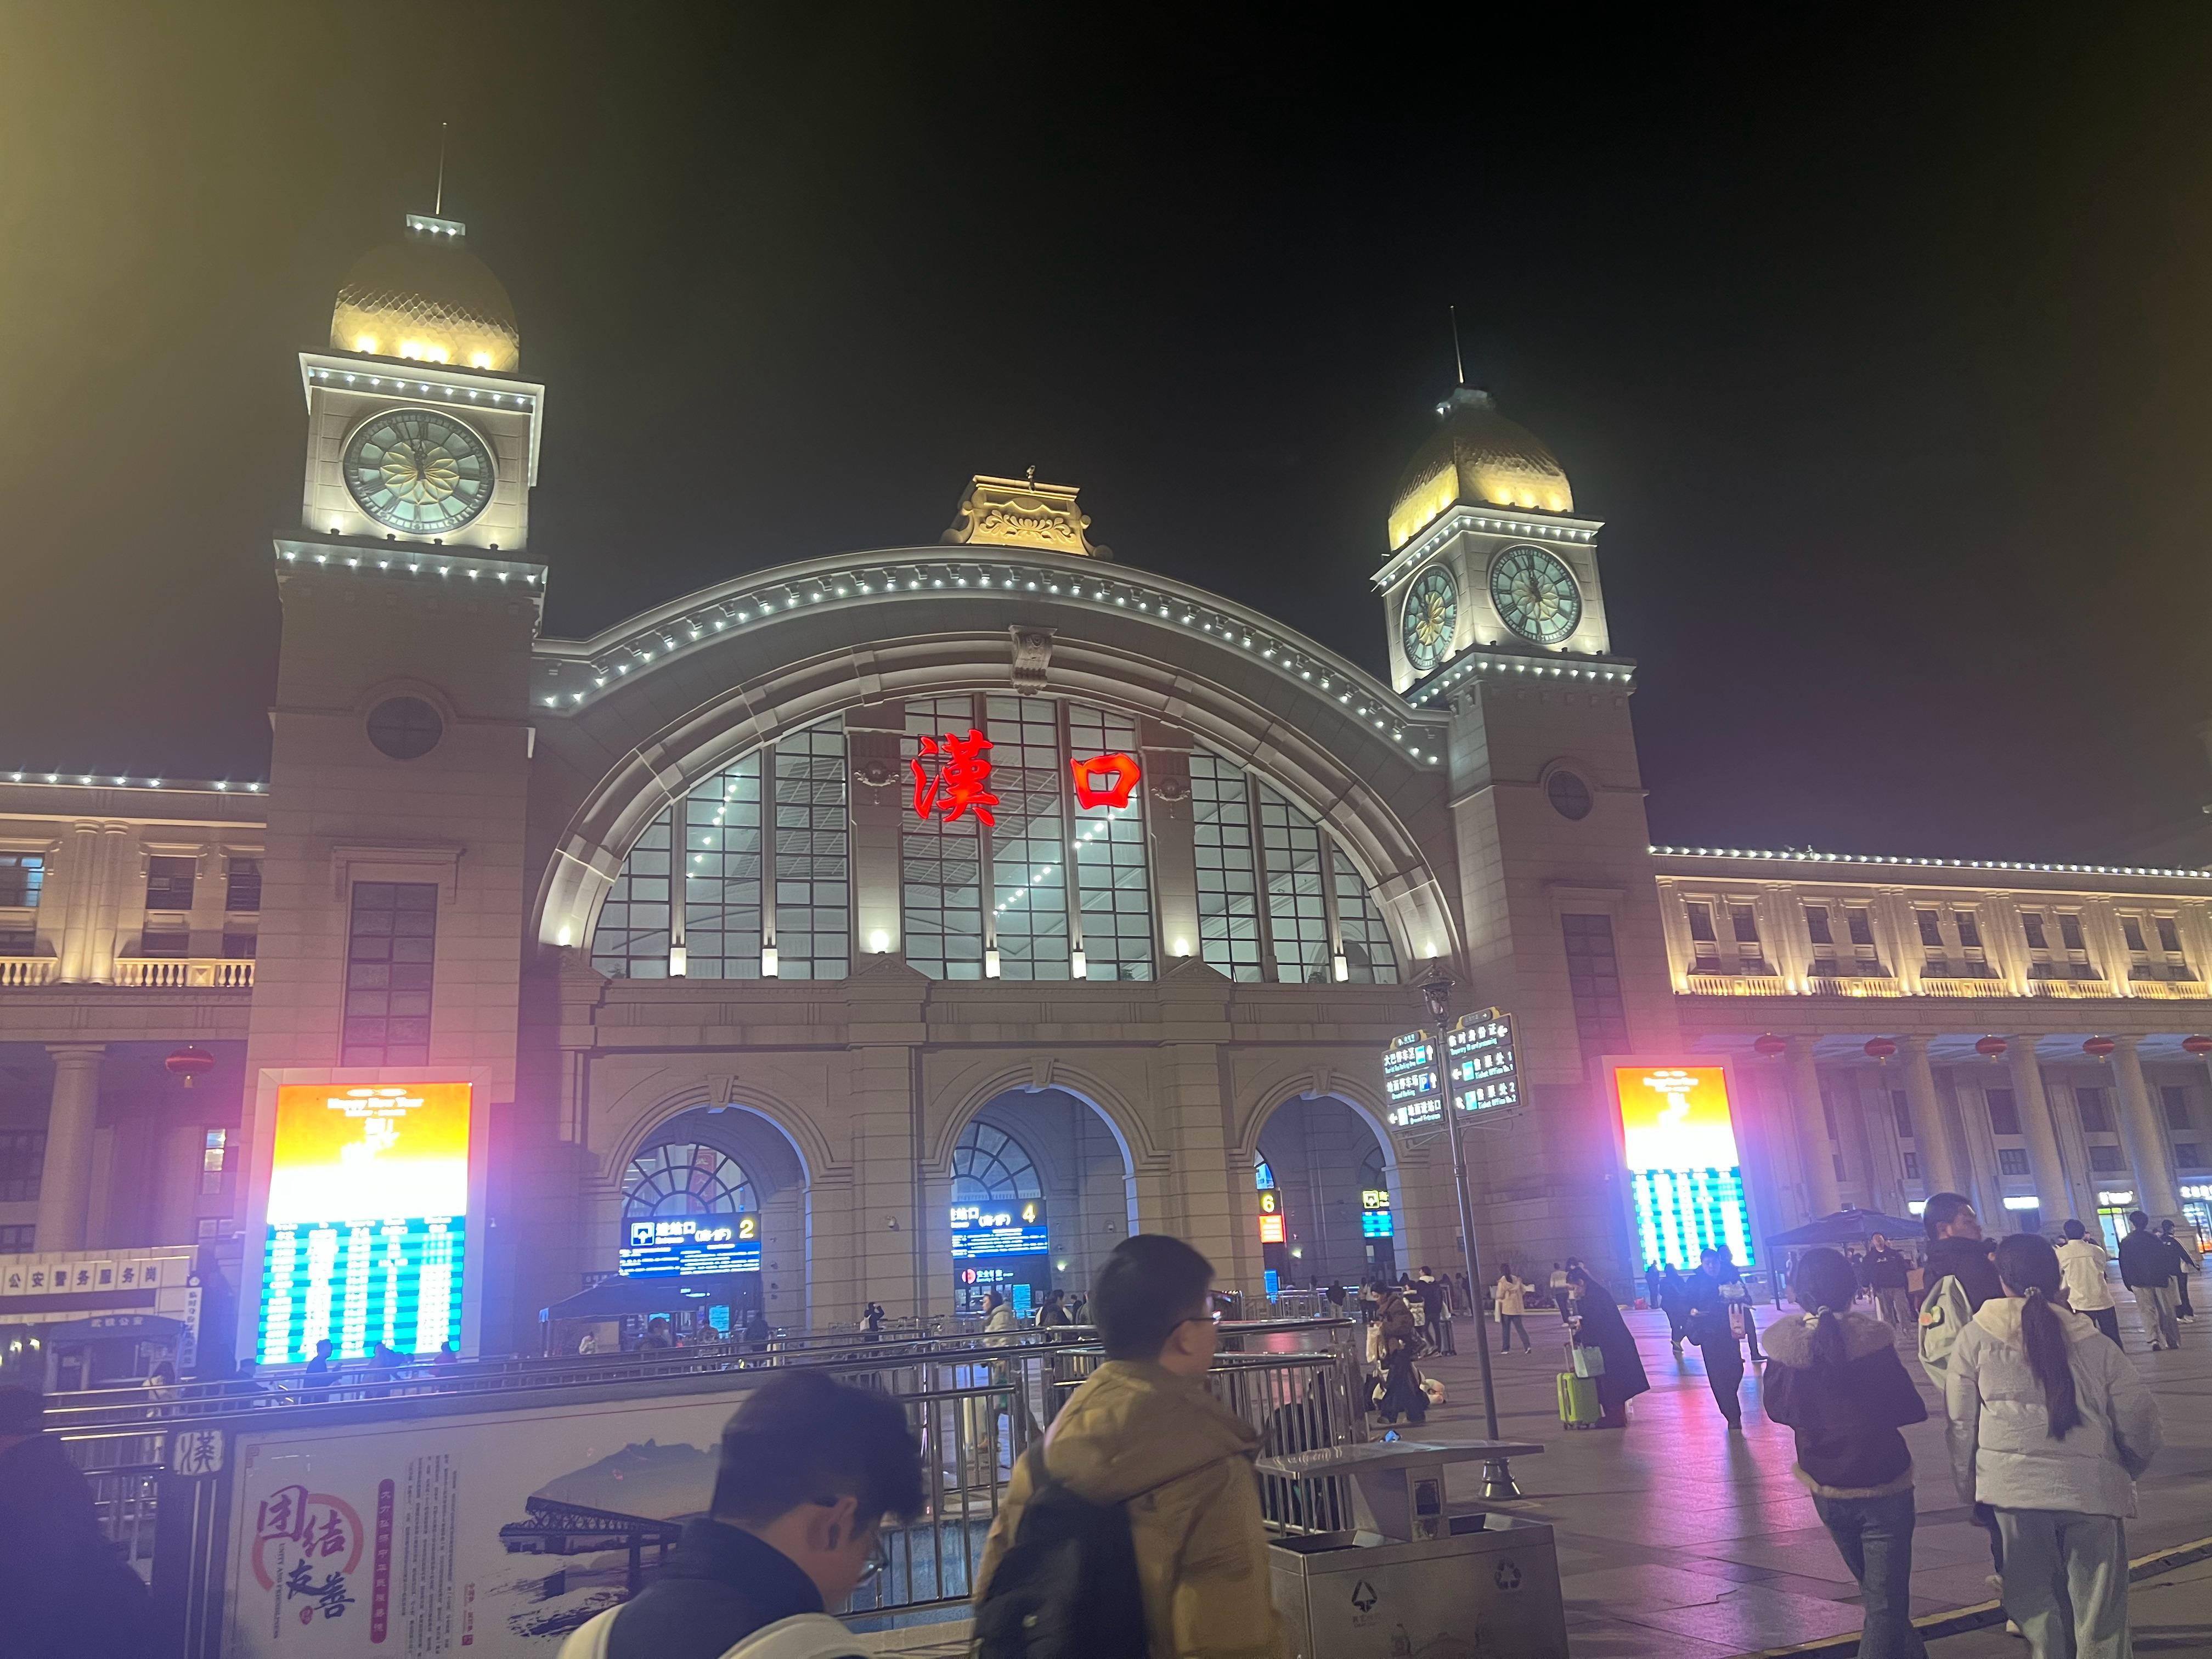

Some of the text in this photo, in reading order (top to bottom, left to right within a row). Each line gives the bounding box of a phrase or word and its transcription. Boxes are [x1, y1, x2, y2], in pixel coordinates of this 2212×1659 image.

[911, 729, 1141, 826] 漢口
[1262, 1194, 1275, 1212] 6
[1022, 1205, 1036, 1223] 4
[739, 1219, 754, 1239] 2
[8, 1266, 157, 1288] 公安警务服务岗
[256, 1485, 346, 1558] 团结
